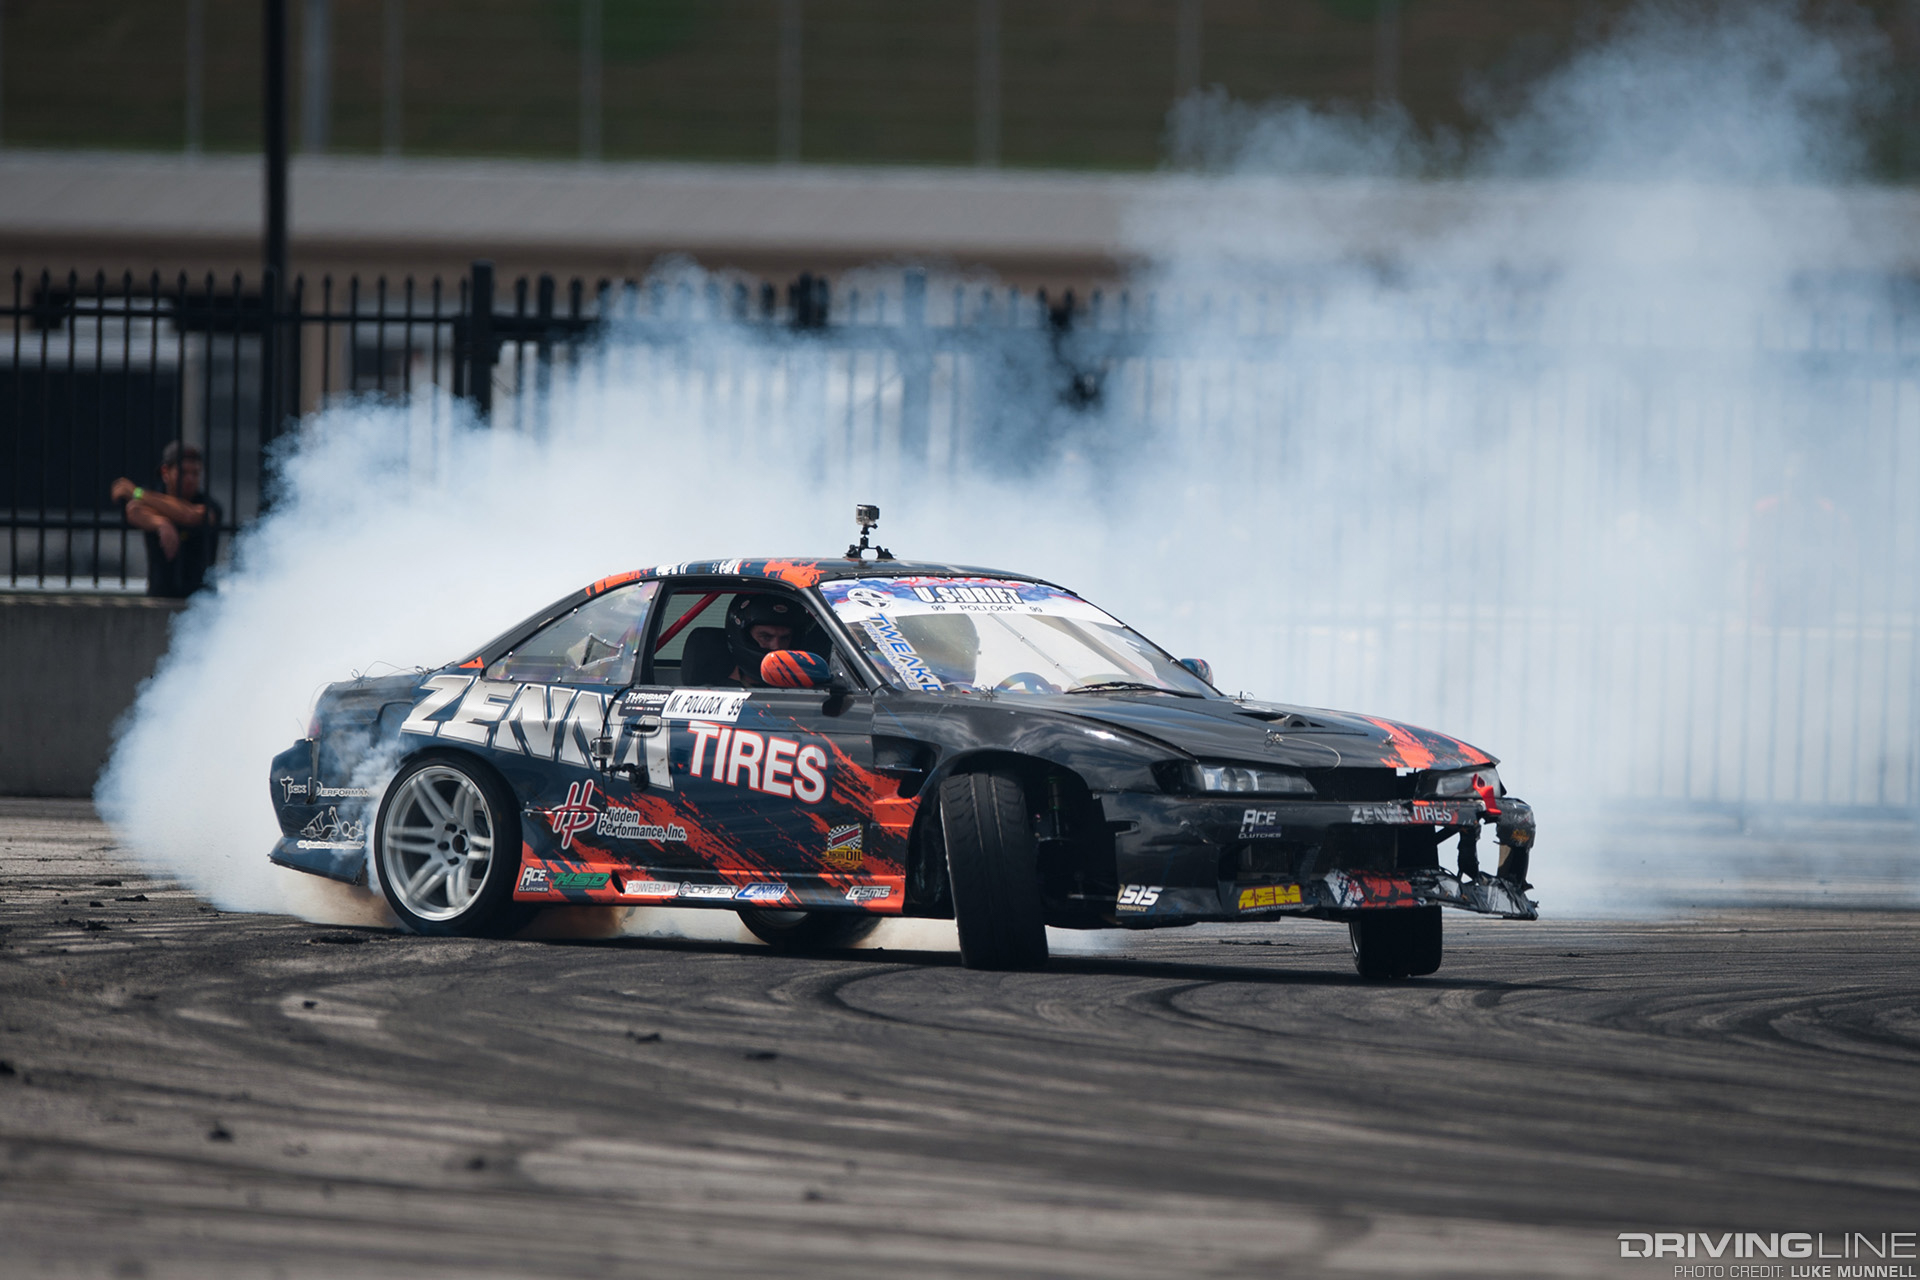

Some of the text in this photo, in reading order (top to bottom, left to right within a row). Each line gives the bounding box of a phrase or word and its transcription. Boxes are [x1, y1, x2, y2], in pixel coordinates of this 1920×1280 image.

[863, 622, 918, 689] PERFORMANCE
[682, 695, 727, 715] POLLOCK
[688, 720, 828, 804] TIRES
[1240, 809, 1277, 832] ACE
[1413, 805, 1452, 822] TIRES
[667, 824, 687, 839] Inc.
[846, 850, 863, 861] OIL
[520, 867, 547, 886] ACE
[553, 873, 611, 887] HSD
[1238, 884, 1302, 910] AEM
